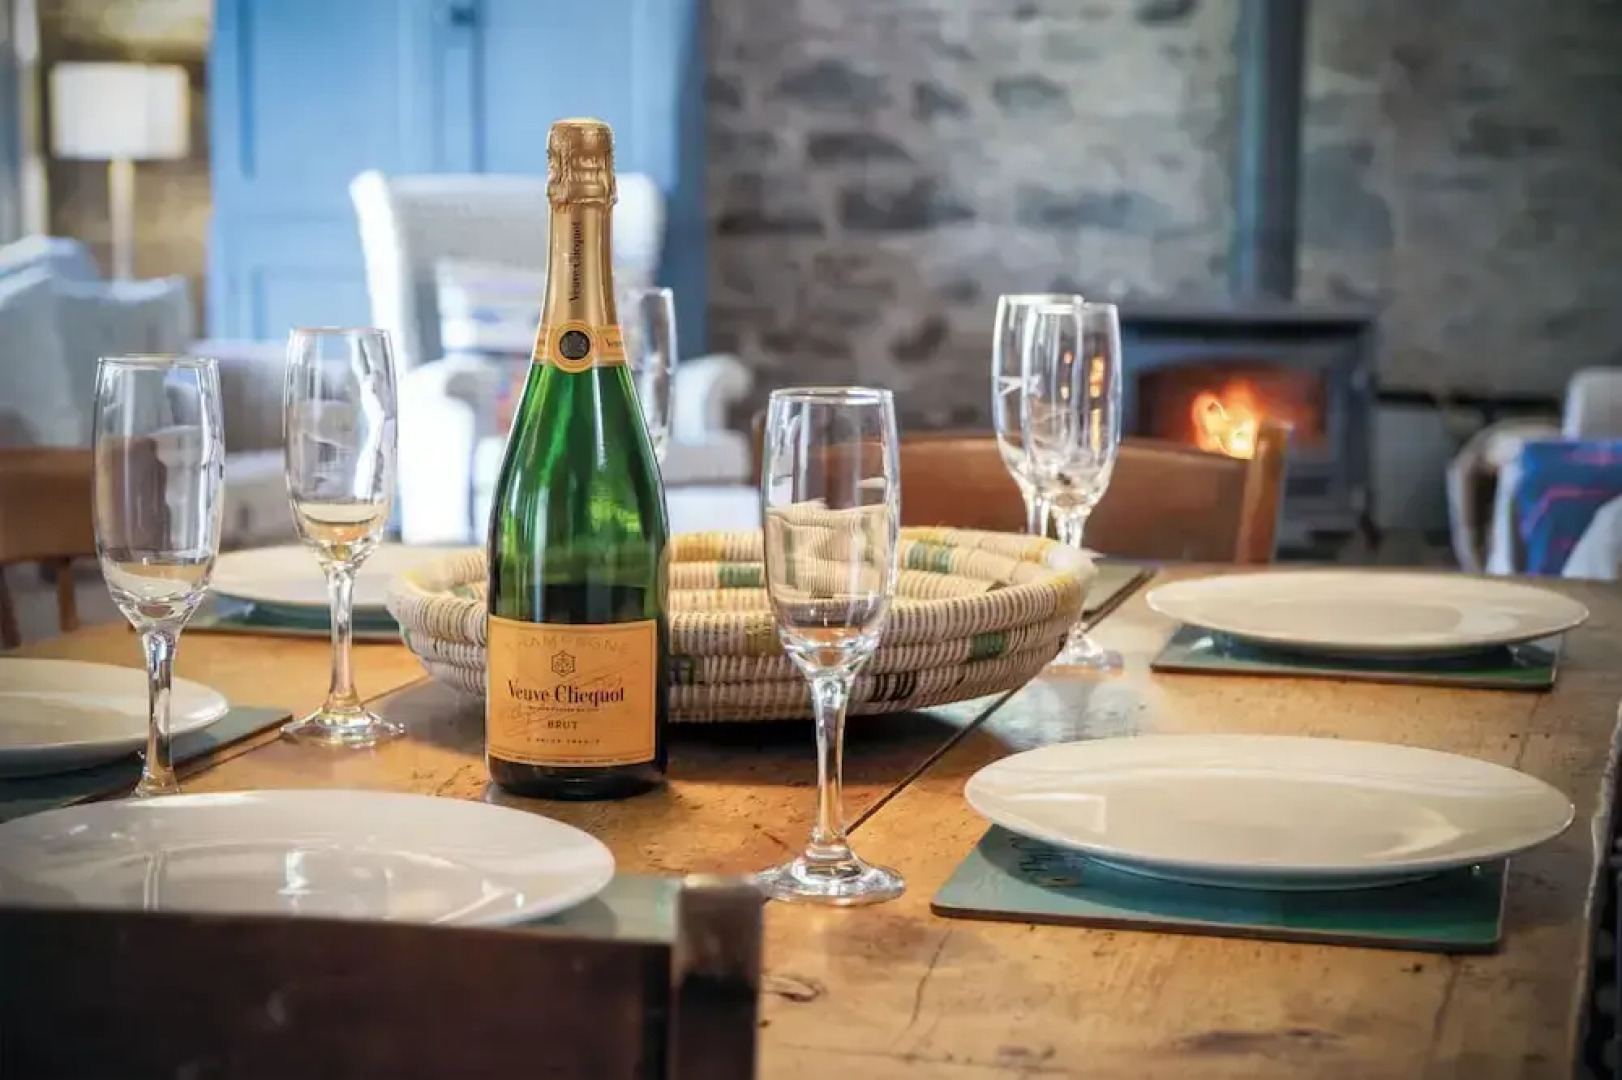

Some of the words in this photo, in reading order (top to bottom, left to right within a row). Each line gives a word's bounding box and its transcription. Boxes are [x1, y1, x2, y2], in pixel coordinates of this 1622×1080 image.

[507, 677, 551, 702] Veuve
[554, 684, 625, 707] Clicquot
[547, 720, 579, 730] BRUT
